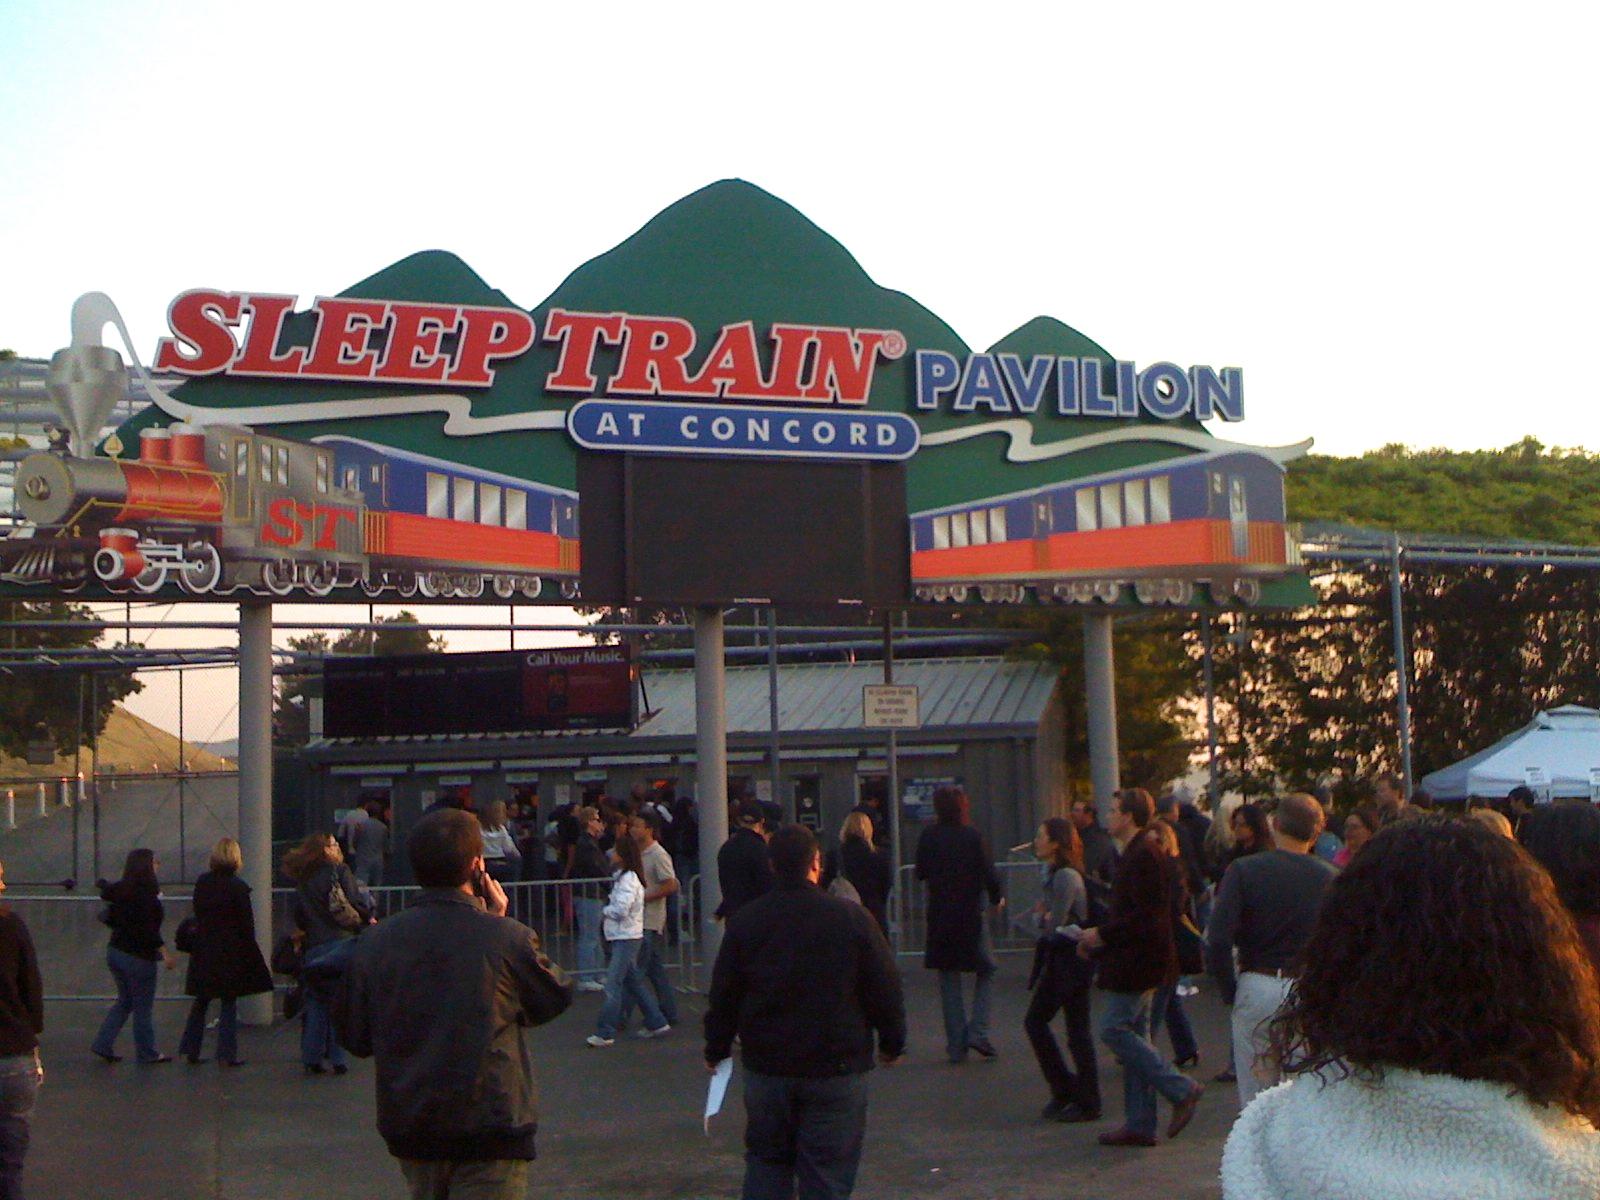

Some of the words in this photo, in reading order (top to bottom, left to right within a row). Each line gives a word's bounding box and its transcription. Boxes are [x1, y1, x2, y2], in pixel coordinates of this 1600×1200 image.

[153, 287, 536, 388] SLEEP
[916, 350, 1244, 422] PAVILION
[596, 411, 646, 438] AT
[679, 415, 898, 446] CONCORD
[262, 499, 356, 550] ST
[526, 653, 550, 666] Call
[552, 650, 581, 664] Your
